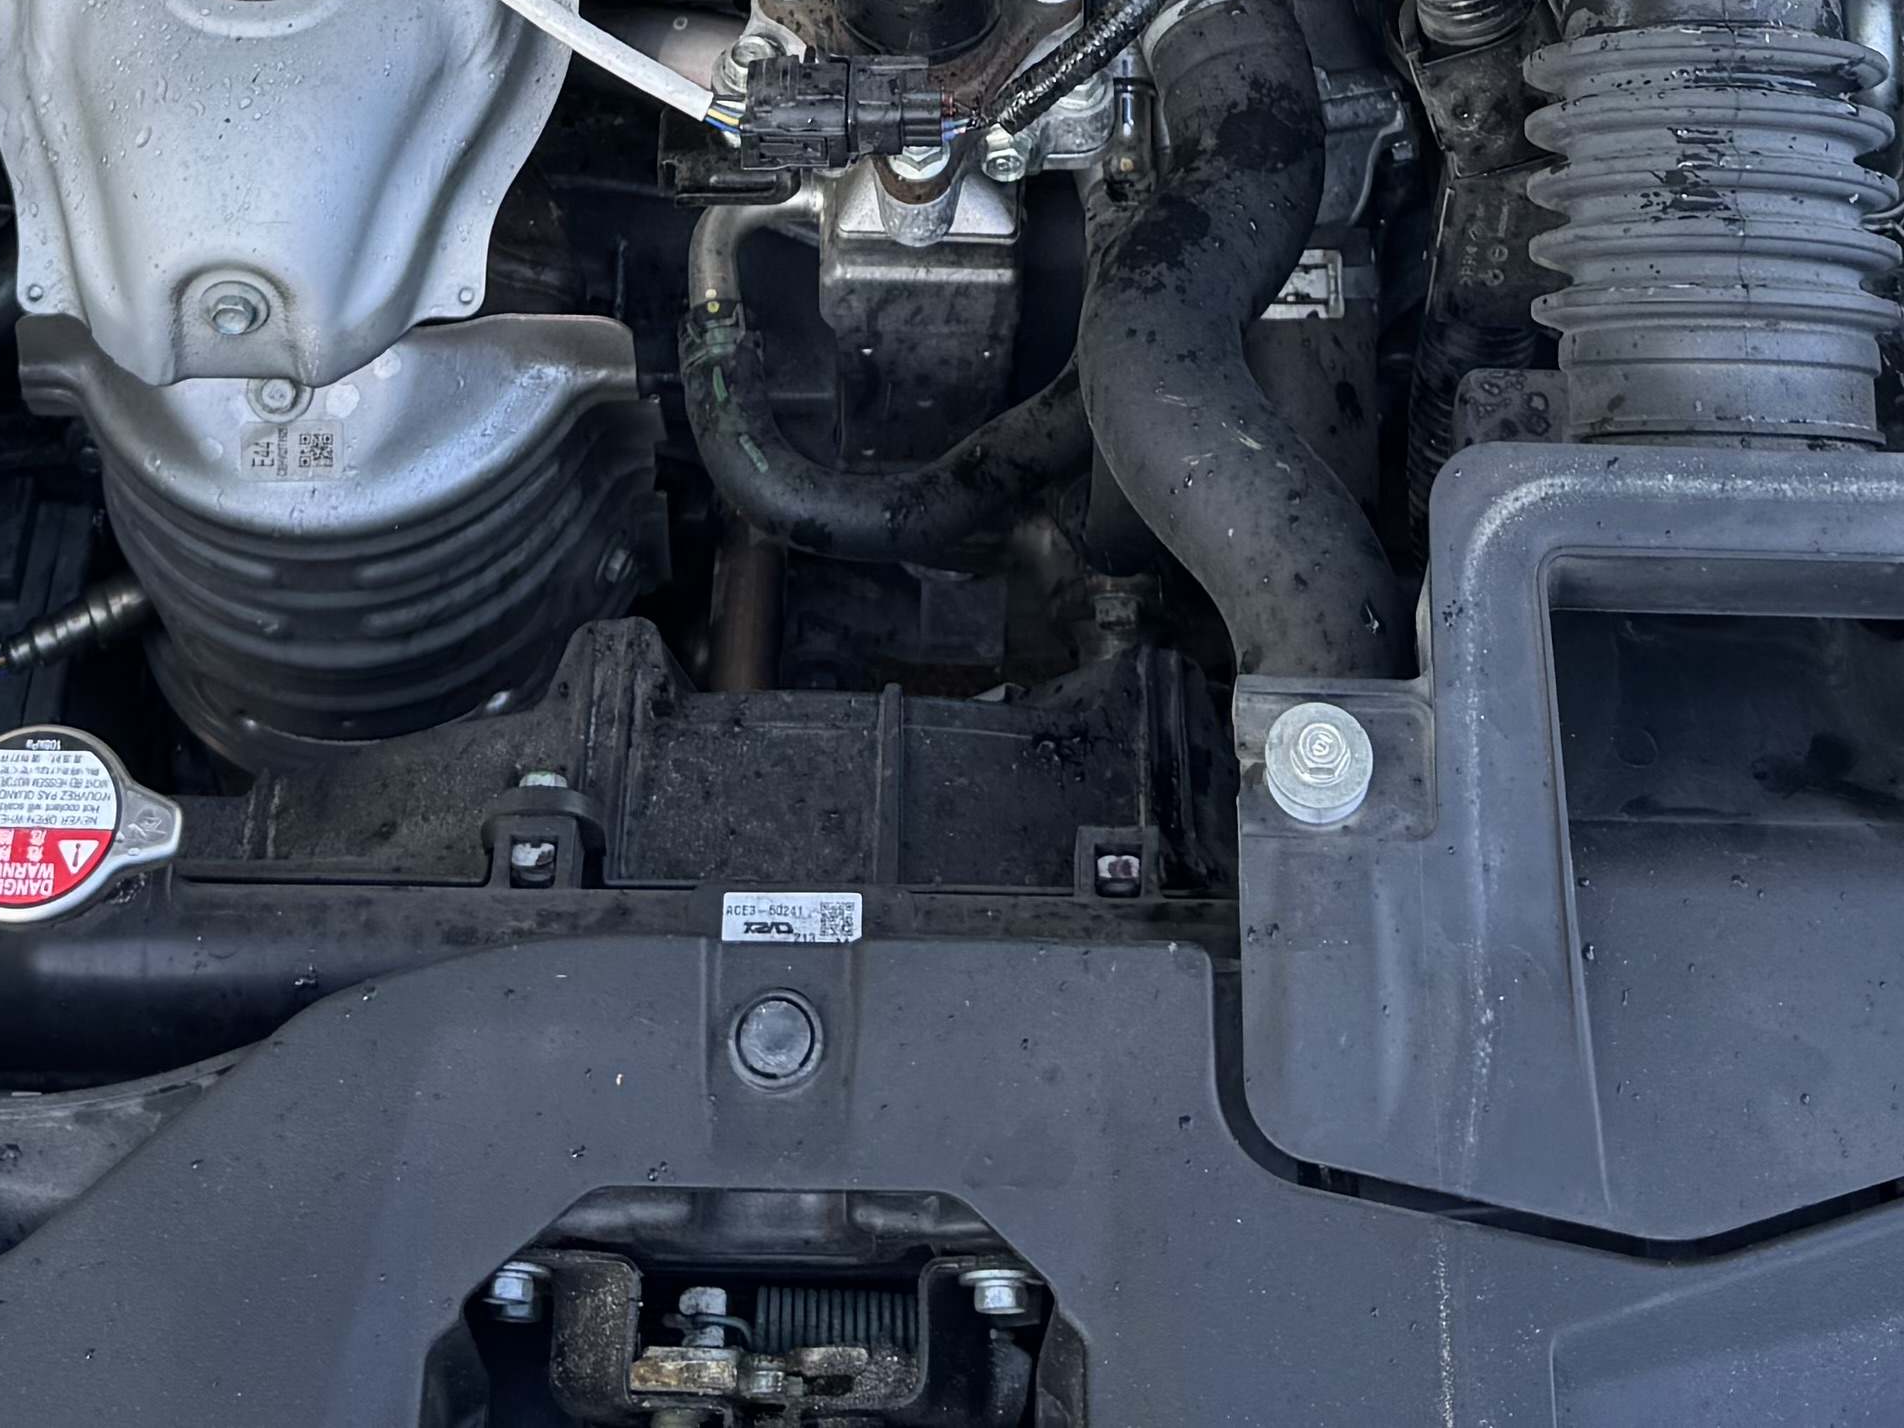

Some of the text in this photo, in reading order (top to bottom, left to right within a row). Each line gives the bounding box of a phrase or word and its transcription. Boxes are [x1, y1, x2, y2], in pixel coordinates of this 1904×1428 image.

[251, 441, 274, 466] E44
[37, 790, 57, 799] PAS
[0, 802, 24, 810] scald
[27, 802, 40, 811] will
[44, 803, 79, 812] coolant
[82, 804, 99, 812] Hot
[27, 815, 57, 824] OPEN
[61, 815, 97, 824] NEVER
